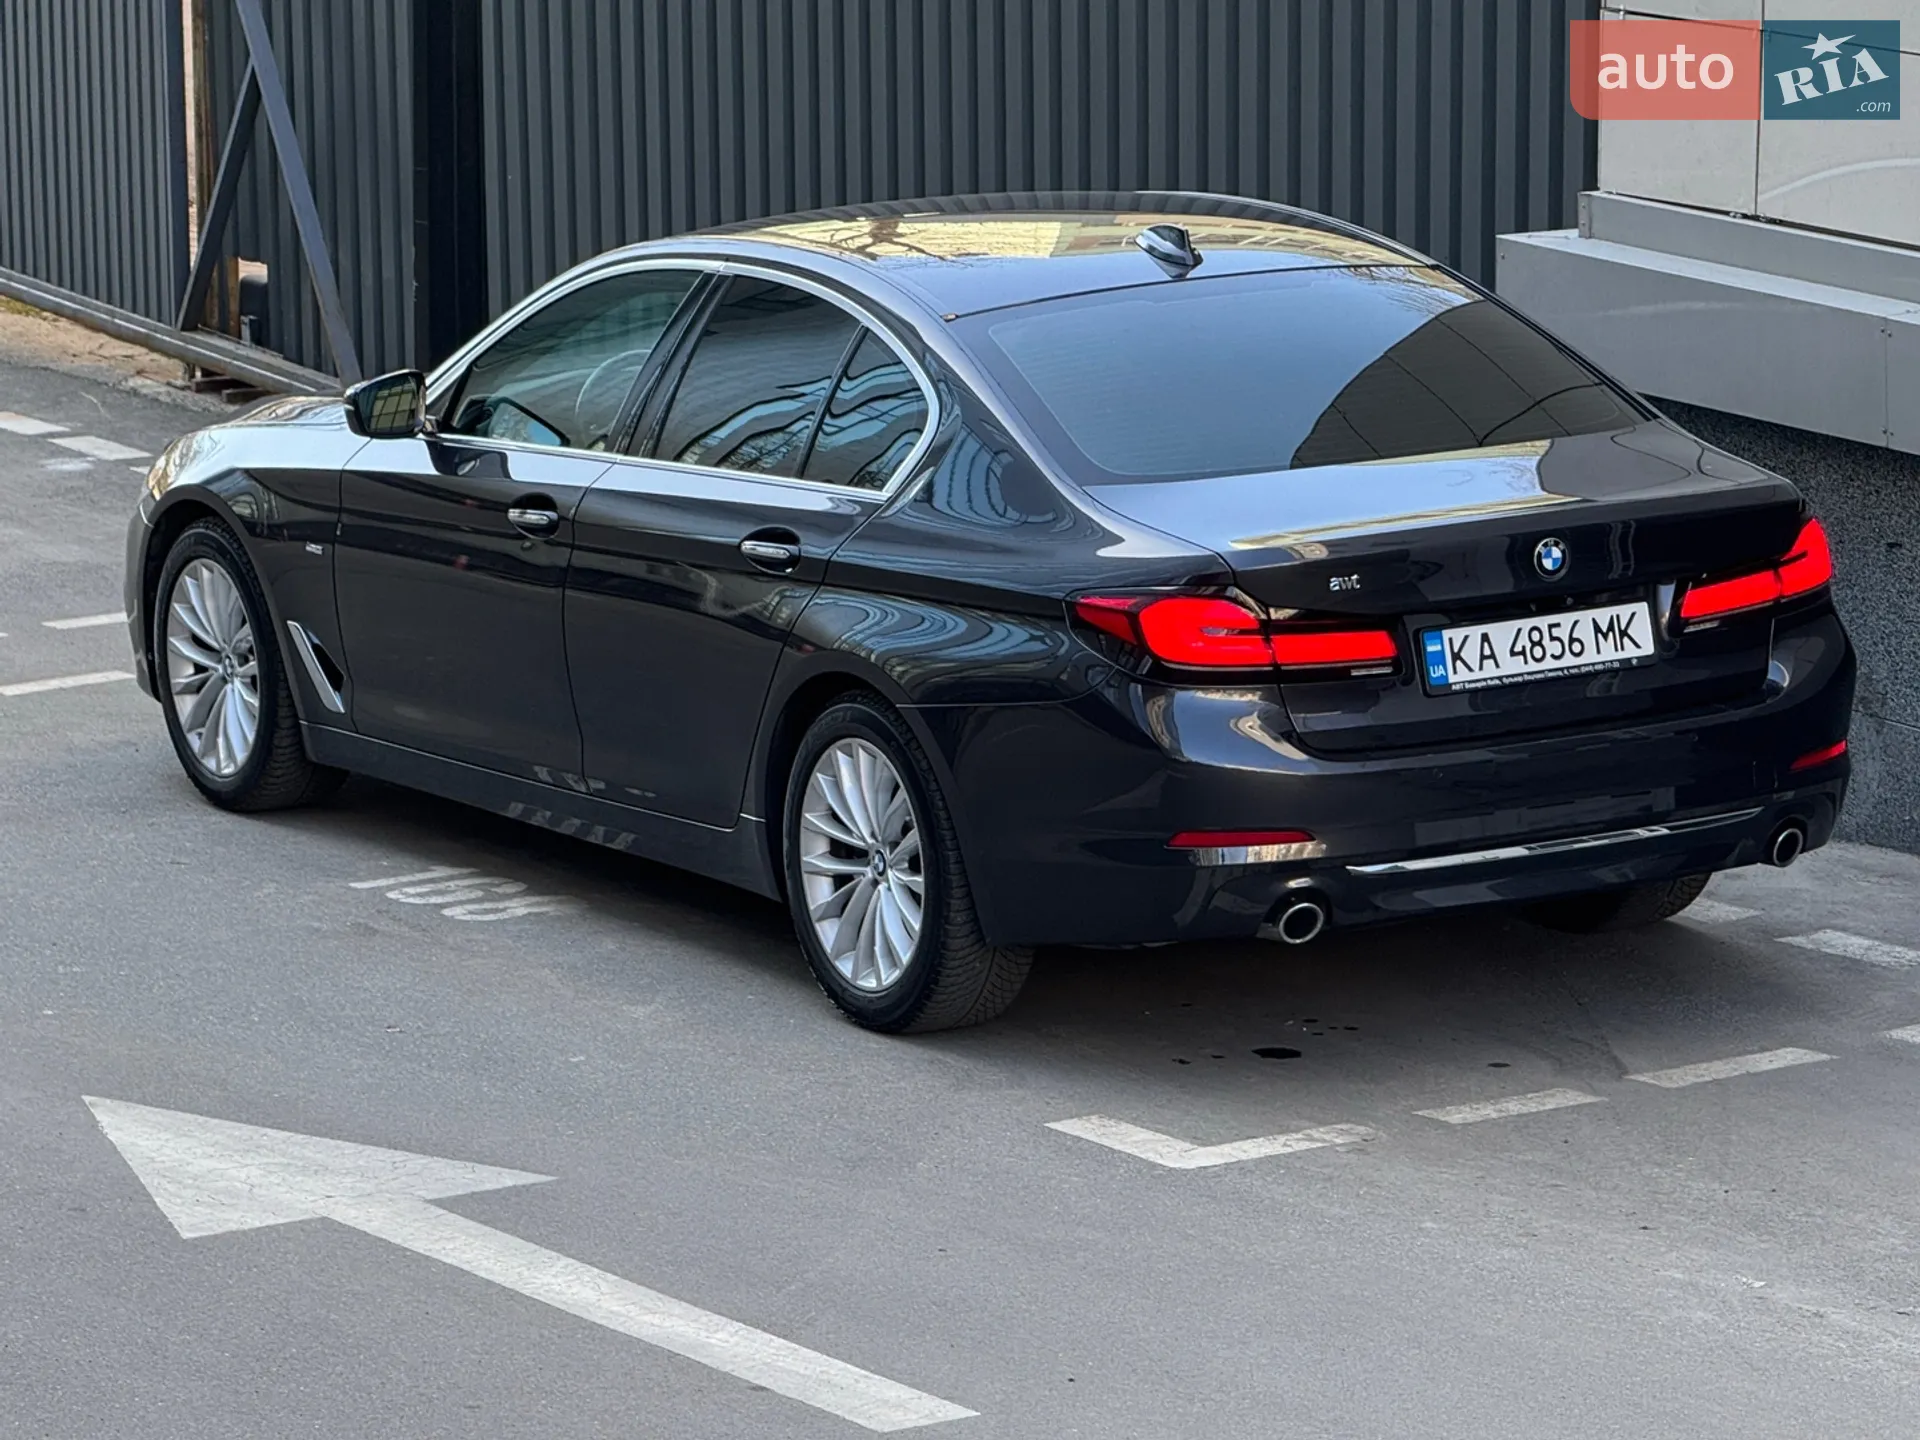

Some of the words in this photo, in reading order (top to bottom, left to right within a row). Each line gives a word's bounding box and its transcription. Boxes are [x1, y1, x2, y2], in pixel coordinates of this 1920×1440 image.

[1448, 632, 1500, 675] KA
[1509, 619, 1585, 666] 4856
[1592, 611, 1642, 655] MK
[1429, 665, 1446, 678] UA
